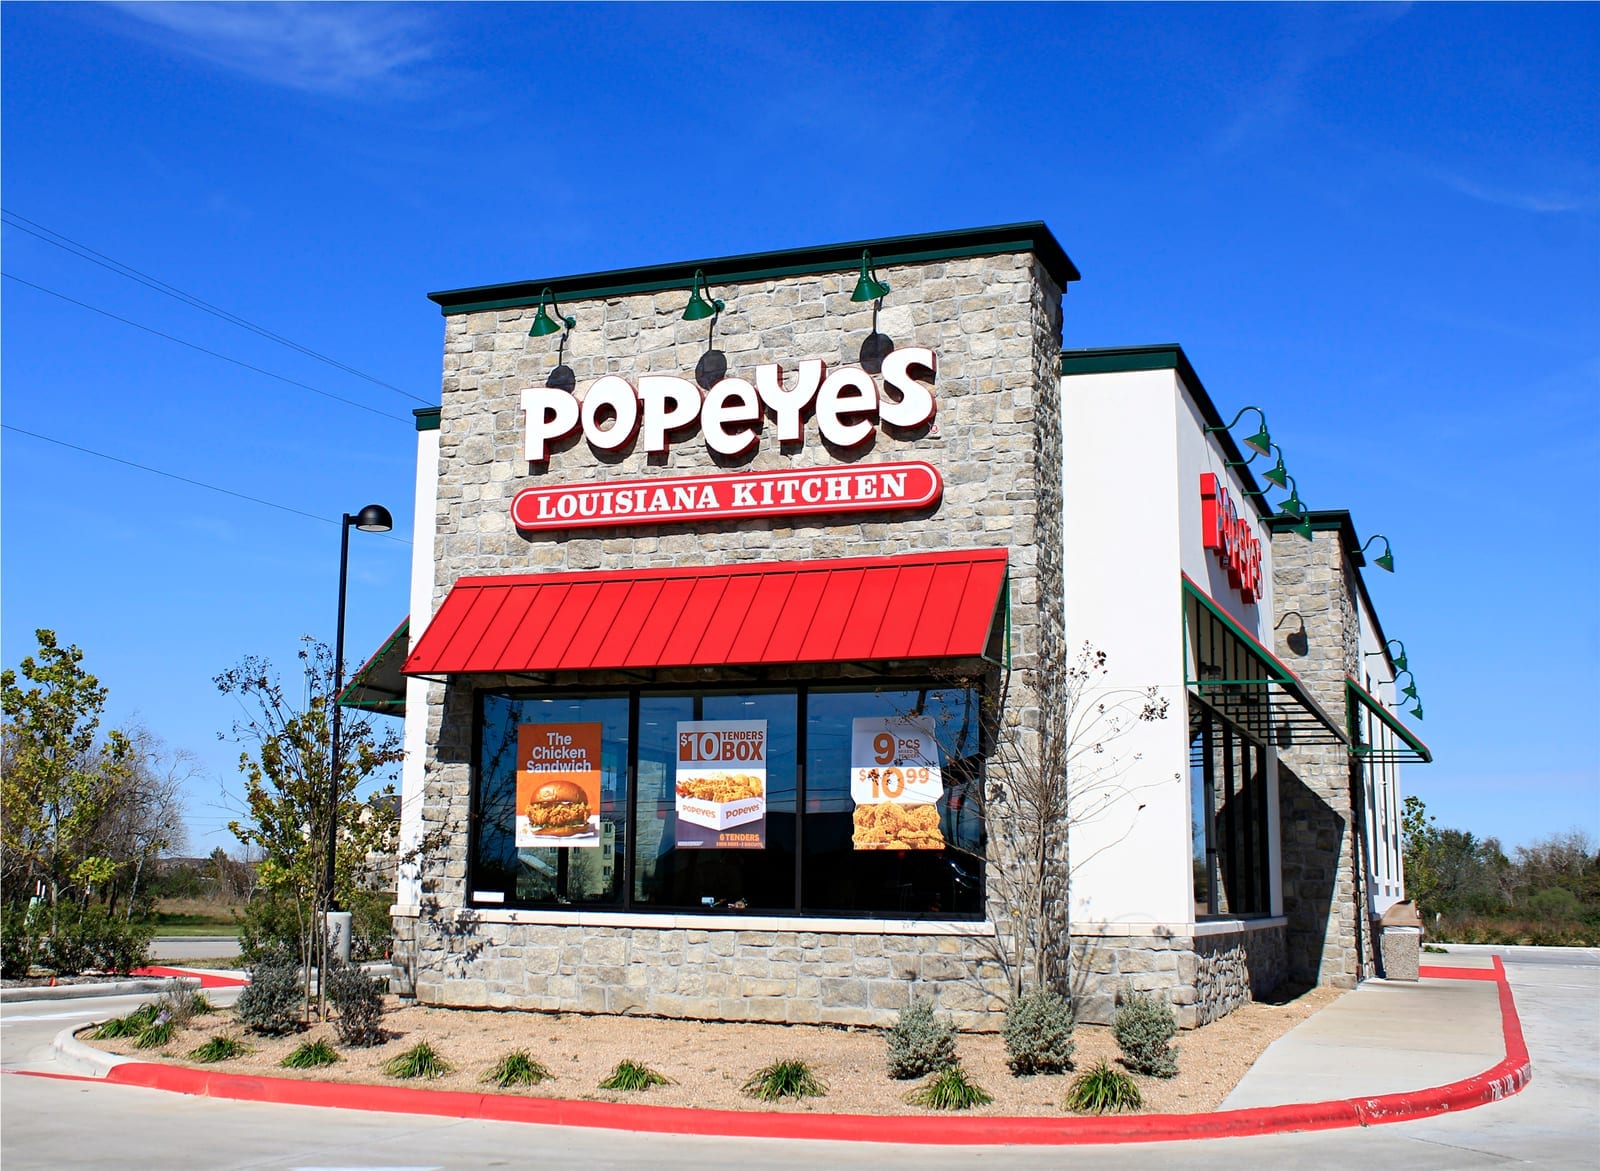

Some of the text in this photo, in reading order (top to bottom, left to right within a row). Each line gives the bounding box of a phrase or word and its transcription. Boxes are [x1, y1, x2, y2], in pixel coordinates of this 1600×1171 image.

[537, 472, 908, 520] LOUISIANA KITCHEN
[546, 732, 573, 746] The
[722, 731, 764, 741] TENDERS
[532, 746, 587, 759] Chicken
[680, 732, 720, 761] $10
[722, 741, 763, 761] BOX
[873, 733, 921, 765] 9 PCS
[526, 759, 592, 774] Sandwich
[726, 833, 760, 841] TENDERS
